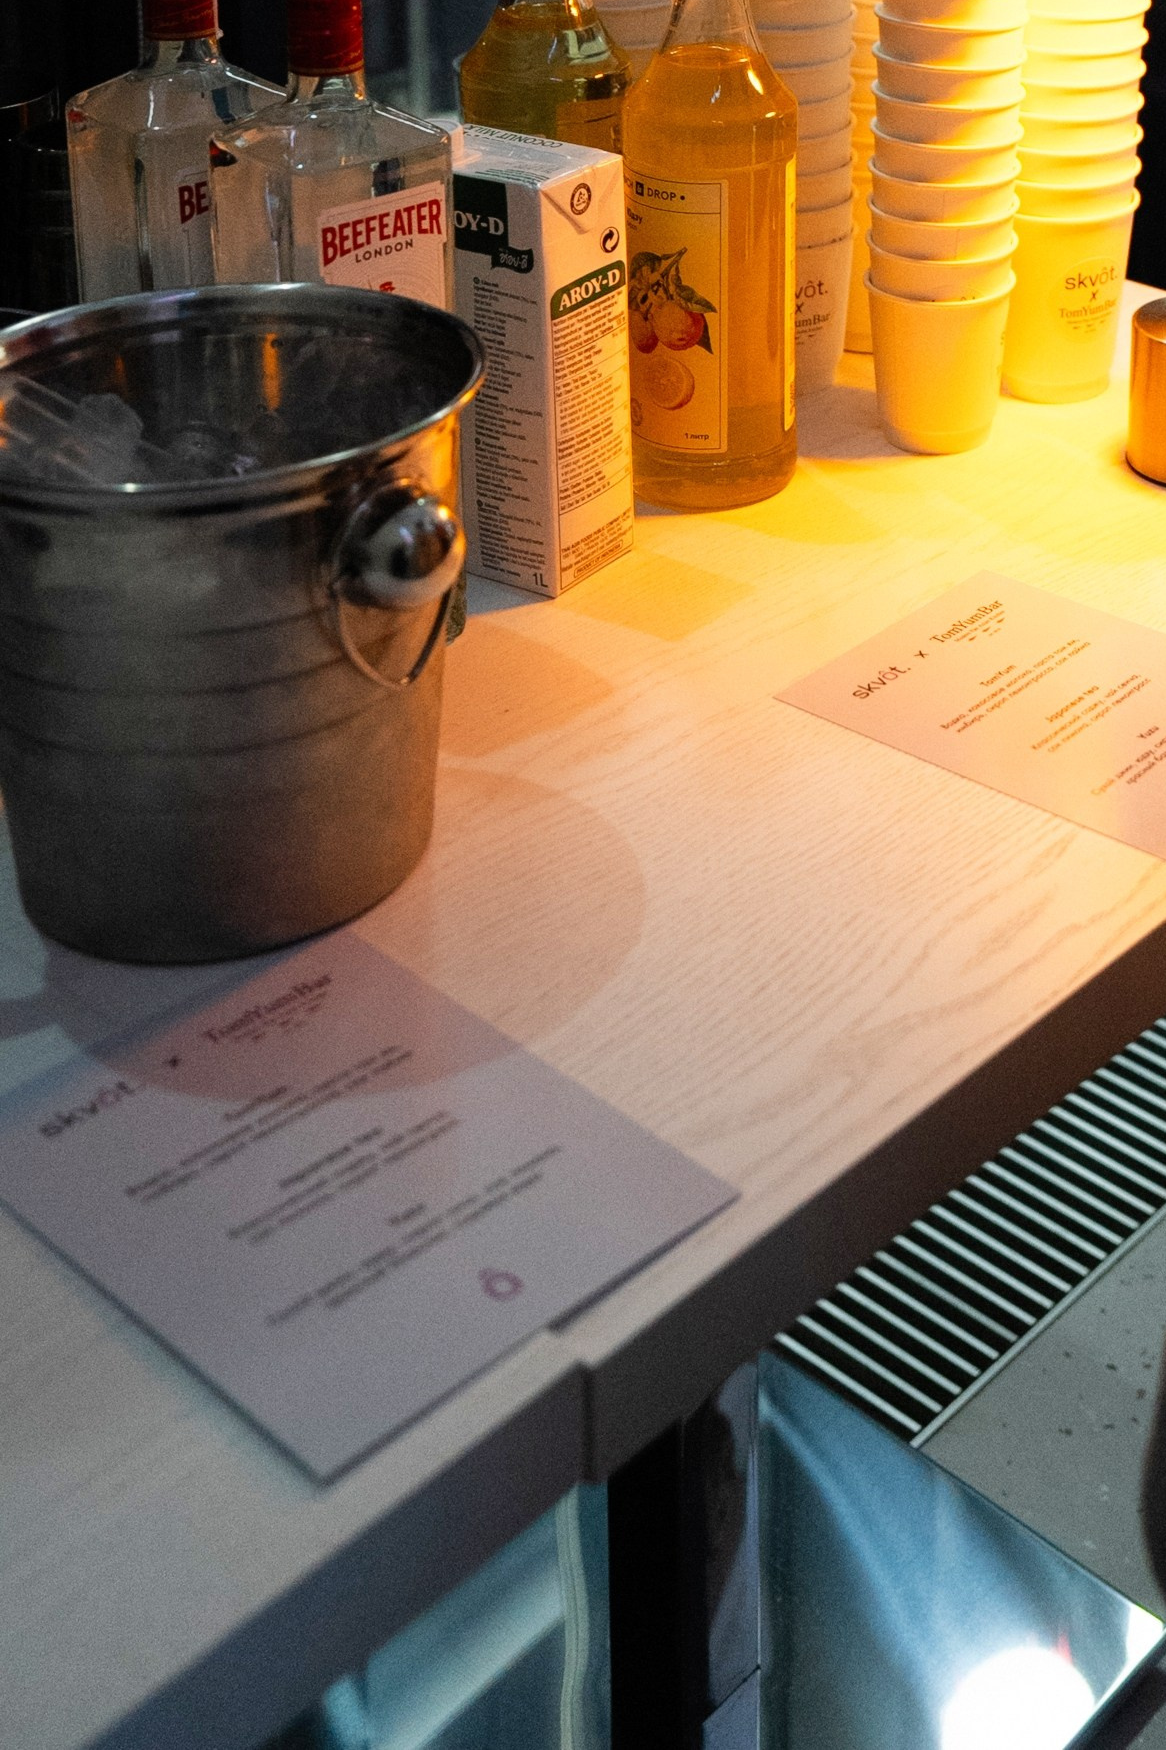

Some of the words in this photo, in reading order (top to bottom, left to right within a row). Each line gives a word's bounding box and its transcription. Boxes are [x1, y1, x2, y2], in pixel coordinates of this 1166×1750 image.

[465, 123, 500, 140] MILK
[499, 131, 563, 148] COCONUT
[647, 187, 677, 201] DROP
[321, 198, 442, 267] BEEFEATER
[455, 210, 505, 236] OY-D
[354, 238, 414, 263] LONDON
[795, 278, 829, 299] vôt.
[1064, 265, 1118, 290] skvôt.
[559, 268, 621, 311] AROY-D
[795, 312, 831, 328] umBar
[532, 572, 549, 588] 1L
[852, 665, 911, 699] skvôt.
[929, 600, 1003, 643] TomYumBar
[979, 664, 1016, 687] TomYum
